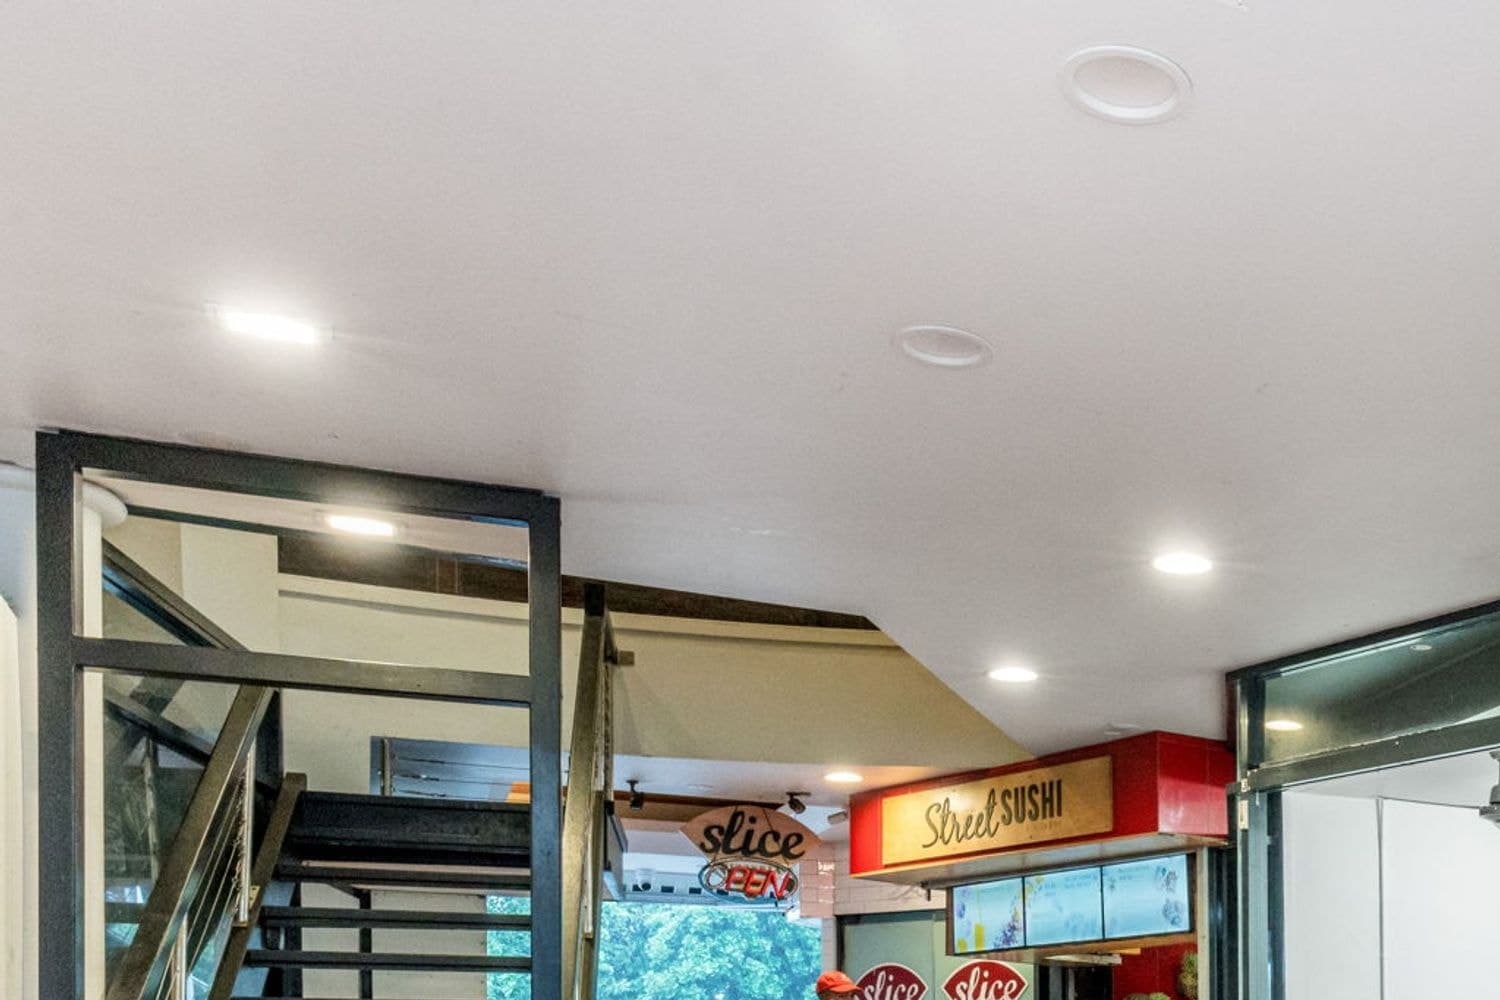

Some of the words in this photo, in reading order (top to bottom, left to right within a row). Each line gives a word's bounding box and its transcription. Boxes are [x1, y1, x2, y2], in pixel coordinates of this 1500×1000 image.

[700, 810, 806, 860] slice
[922, 788, 1000, 849] Street
[1001, 779, 1062, 826] SUSHI
[704, 863, 795, 900] OPEN
